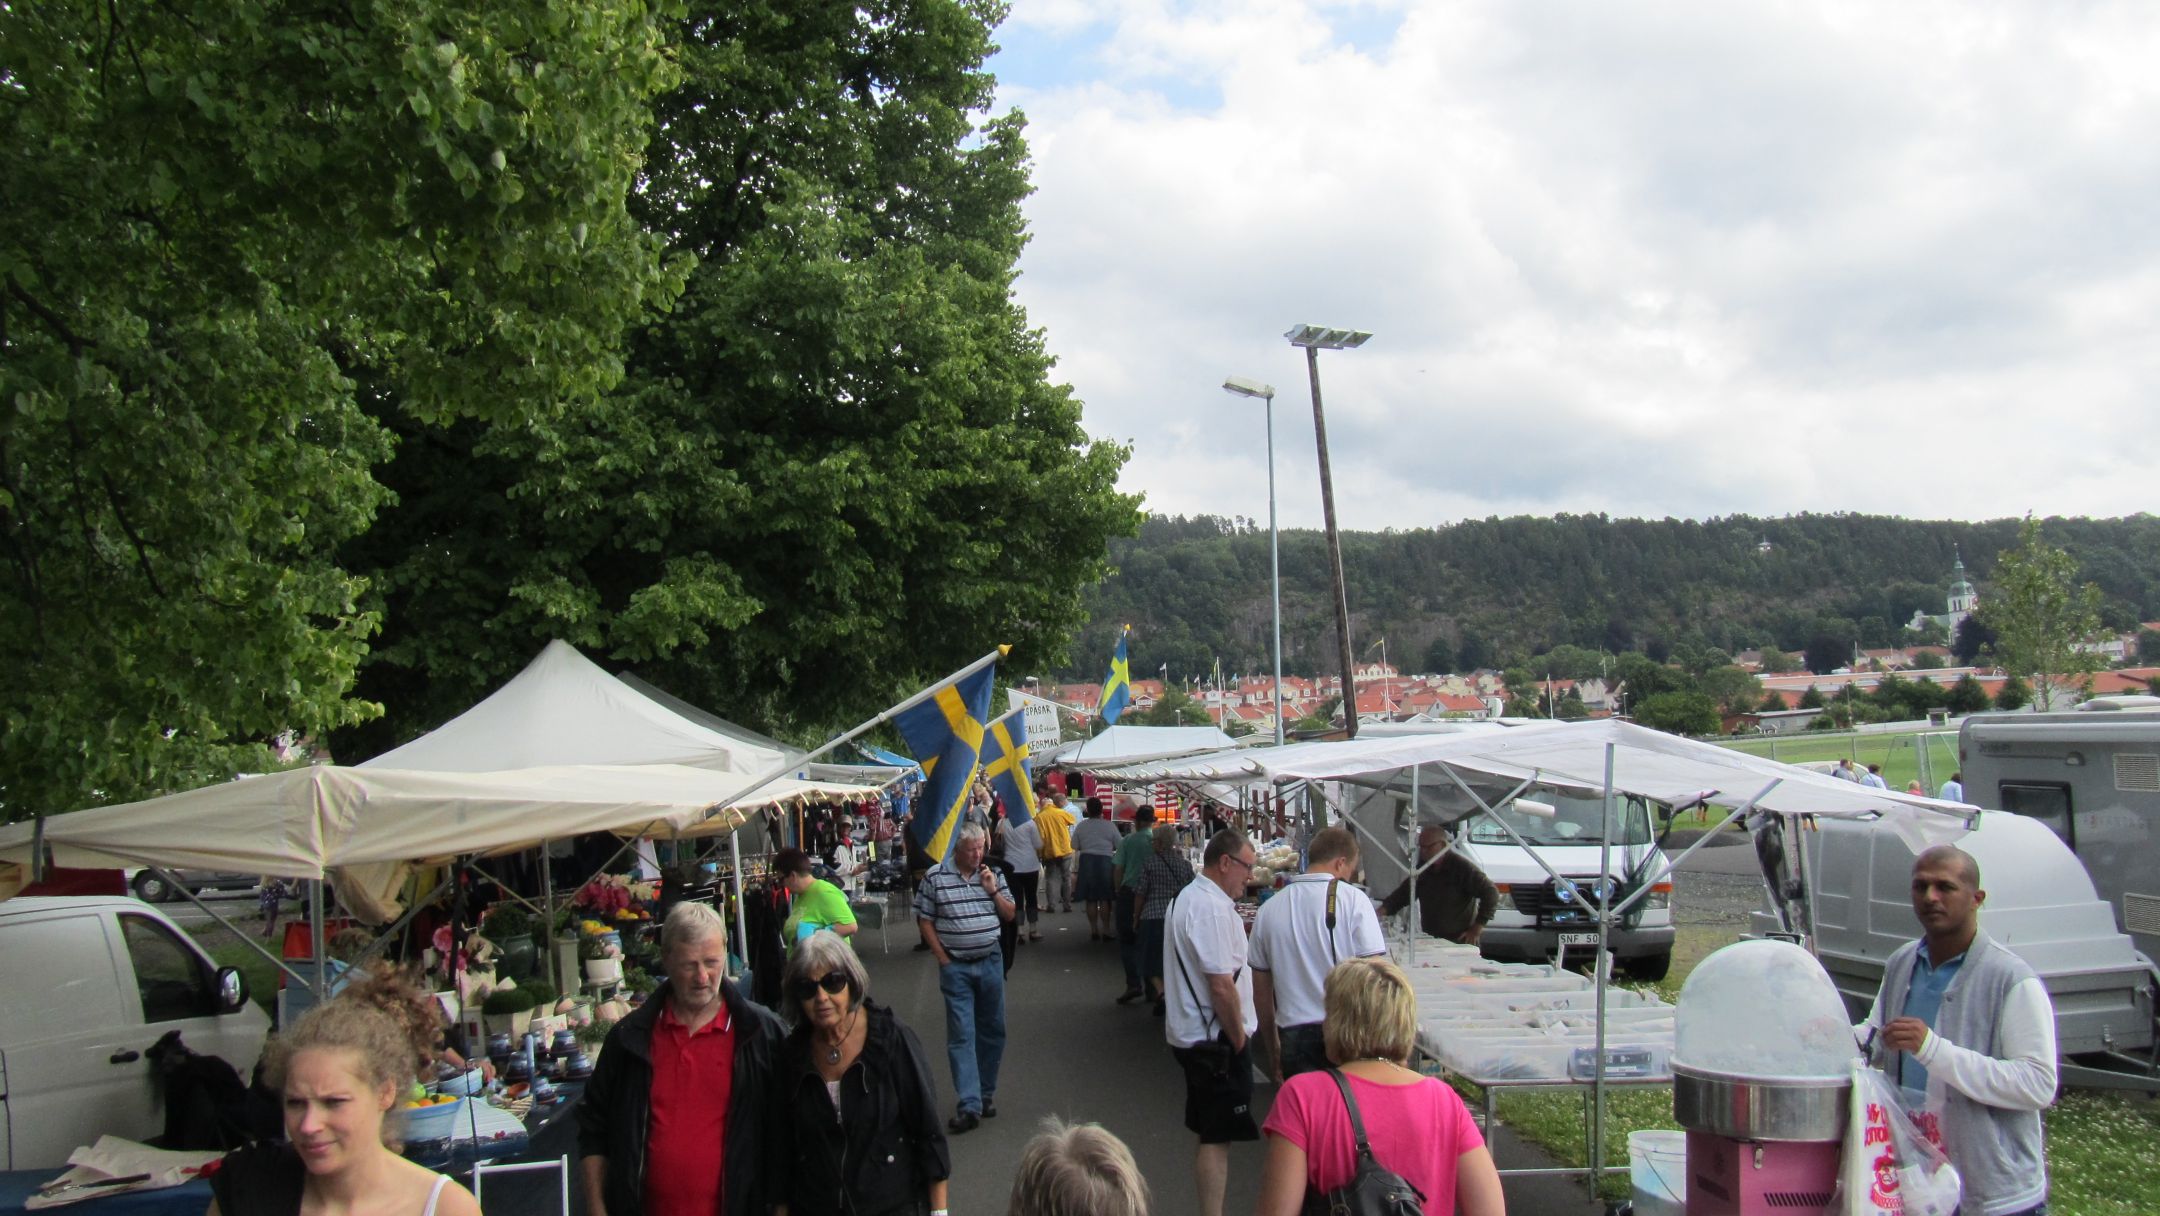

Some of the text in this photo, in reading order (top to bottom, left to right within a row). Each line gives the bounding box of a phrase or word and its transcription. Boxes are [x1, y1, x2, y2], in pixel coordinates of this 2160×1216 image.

[1025, 704, 1052, 716] SPÅSAR
[1027, 739, 1059, 750] KFORMAR
[1560, 934, 1599, 943] SNF 50
